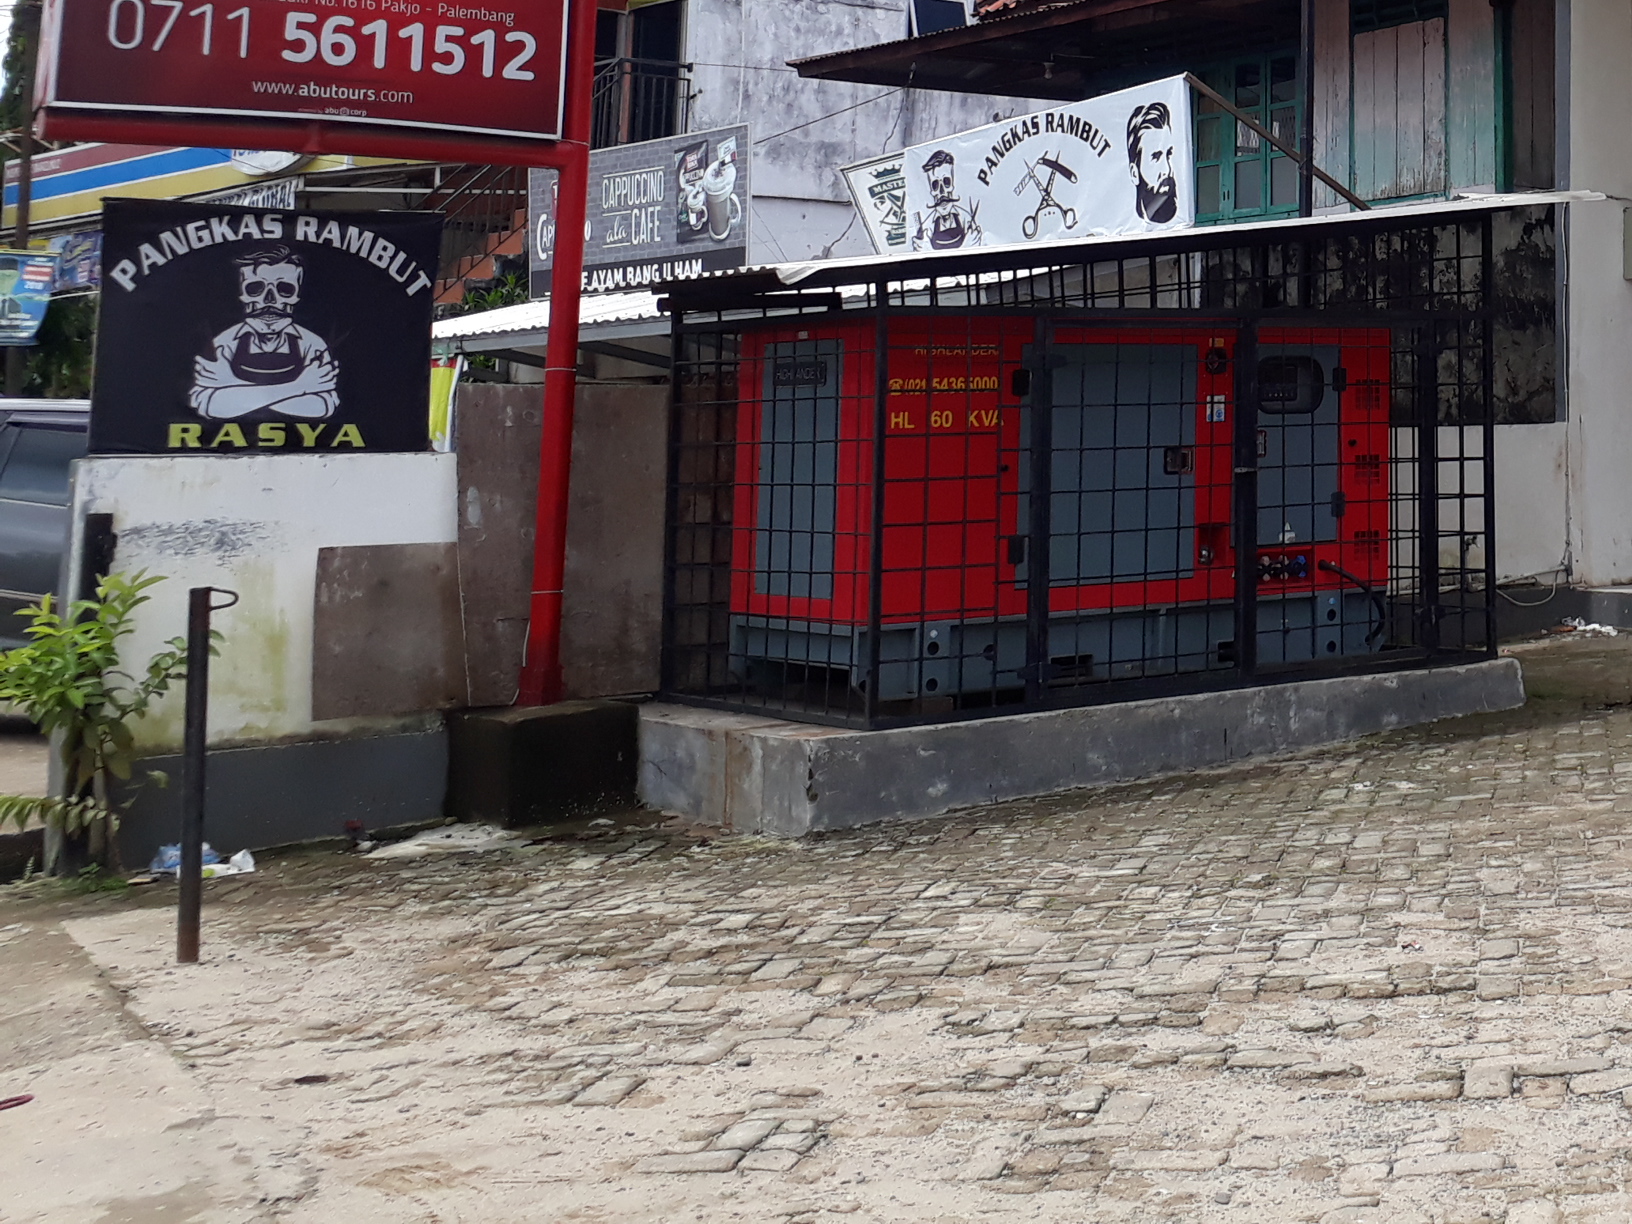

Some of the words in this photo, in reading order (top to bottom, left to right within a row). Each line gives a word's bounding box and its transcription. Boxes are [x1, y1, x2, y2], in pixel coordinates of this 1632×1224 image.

[438, 2, 515, 26] Palembang
[281, 11, 537, 82] 5611512
[252, 80, 414, 104] www.abutours.com
[977, 113, 1041, 187] PANGKAS
[1045, 112, 1113, 158] RAMBUT
[602, 170, 665, 210] CAPPUCCINO
[606, 216, 628, 243] ala
[631, 206, 662, 245] CAFE
[109, 213, 284, 293] PANGKAS
[296, 215, 432, 297] RAMBUT
[167, 423, 366, 448] RASYA
[891, 411, 915, 429] HL
[930, 409, 953, 428] 60
